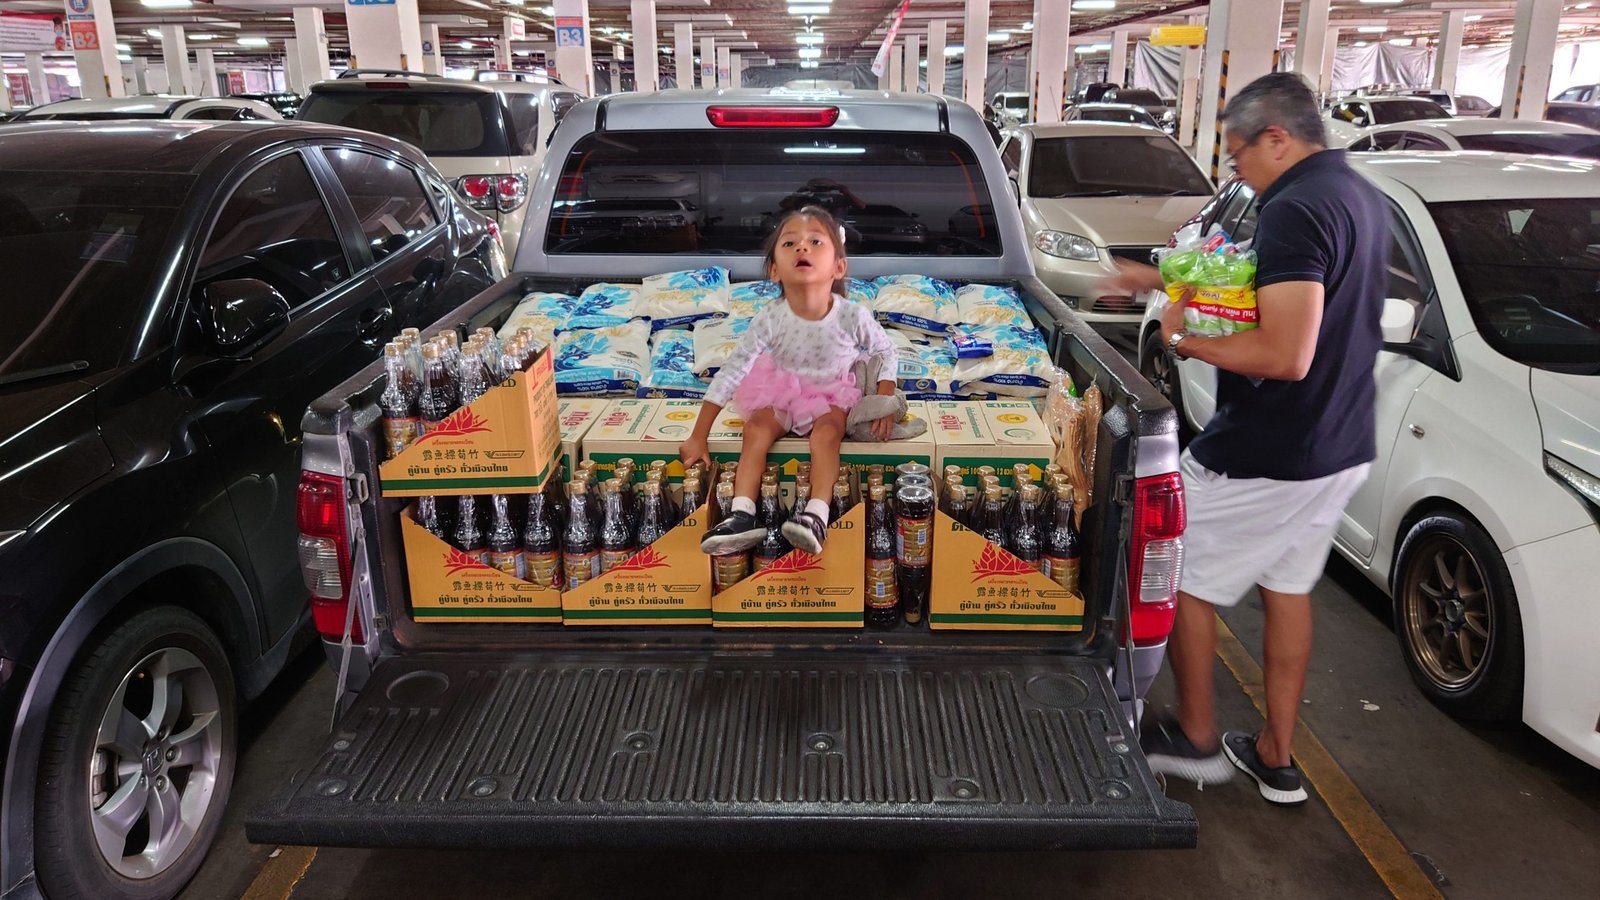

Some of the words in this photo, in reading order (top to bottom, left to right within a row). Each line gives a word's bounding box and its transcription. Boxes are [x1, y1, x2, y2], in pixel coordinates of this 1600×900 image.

[73, 31, 97, 48] B2
[559, 29, 583, 47] B3
[408, 464, 430, 477] คู่บ้าน
[434, 464, 457, 476] คู่ครัว
[460, 462, 508, 473] ทั่วเมืองไทย
[829, 520, 854, 530] OLD
[438, 595, 459, 605] คู่บ้าน
[463, 595, 484, 605] คู่ครัว
[487, 595, 533, 604] ทั่วเมืองไทย
[589, 596, 610, 607] คู่บ้าน
[614, 596, 635, 606] คู่ครัว
[638, 595, 684, 605] ทั่วเมืองไทย
[741, 599, 762, 610] คู่บ้าน
[765, 598, 787, 610] คู่ครัว
[790, 598, 836, 607] ทั่วเมืองไทย
[959, 601, 981, 612] คู่บ้าน
[984, 601, 1006, 611] คู่ครัว
[1009, 599, 1056, 610] ทั่วเมืองไทย
